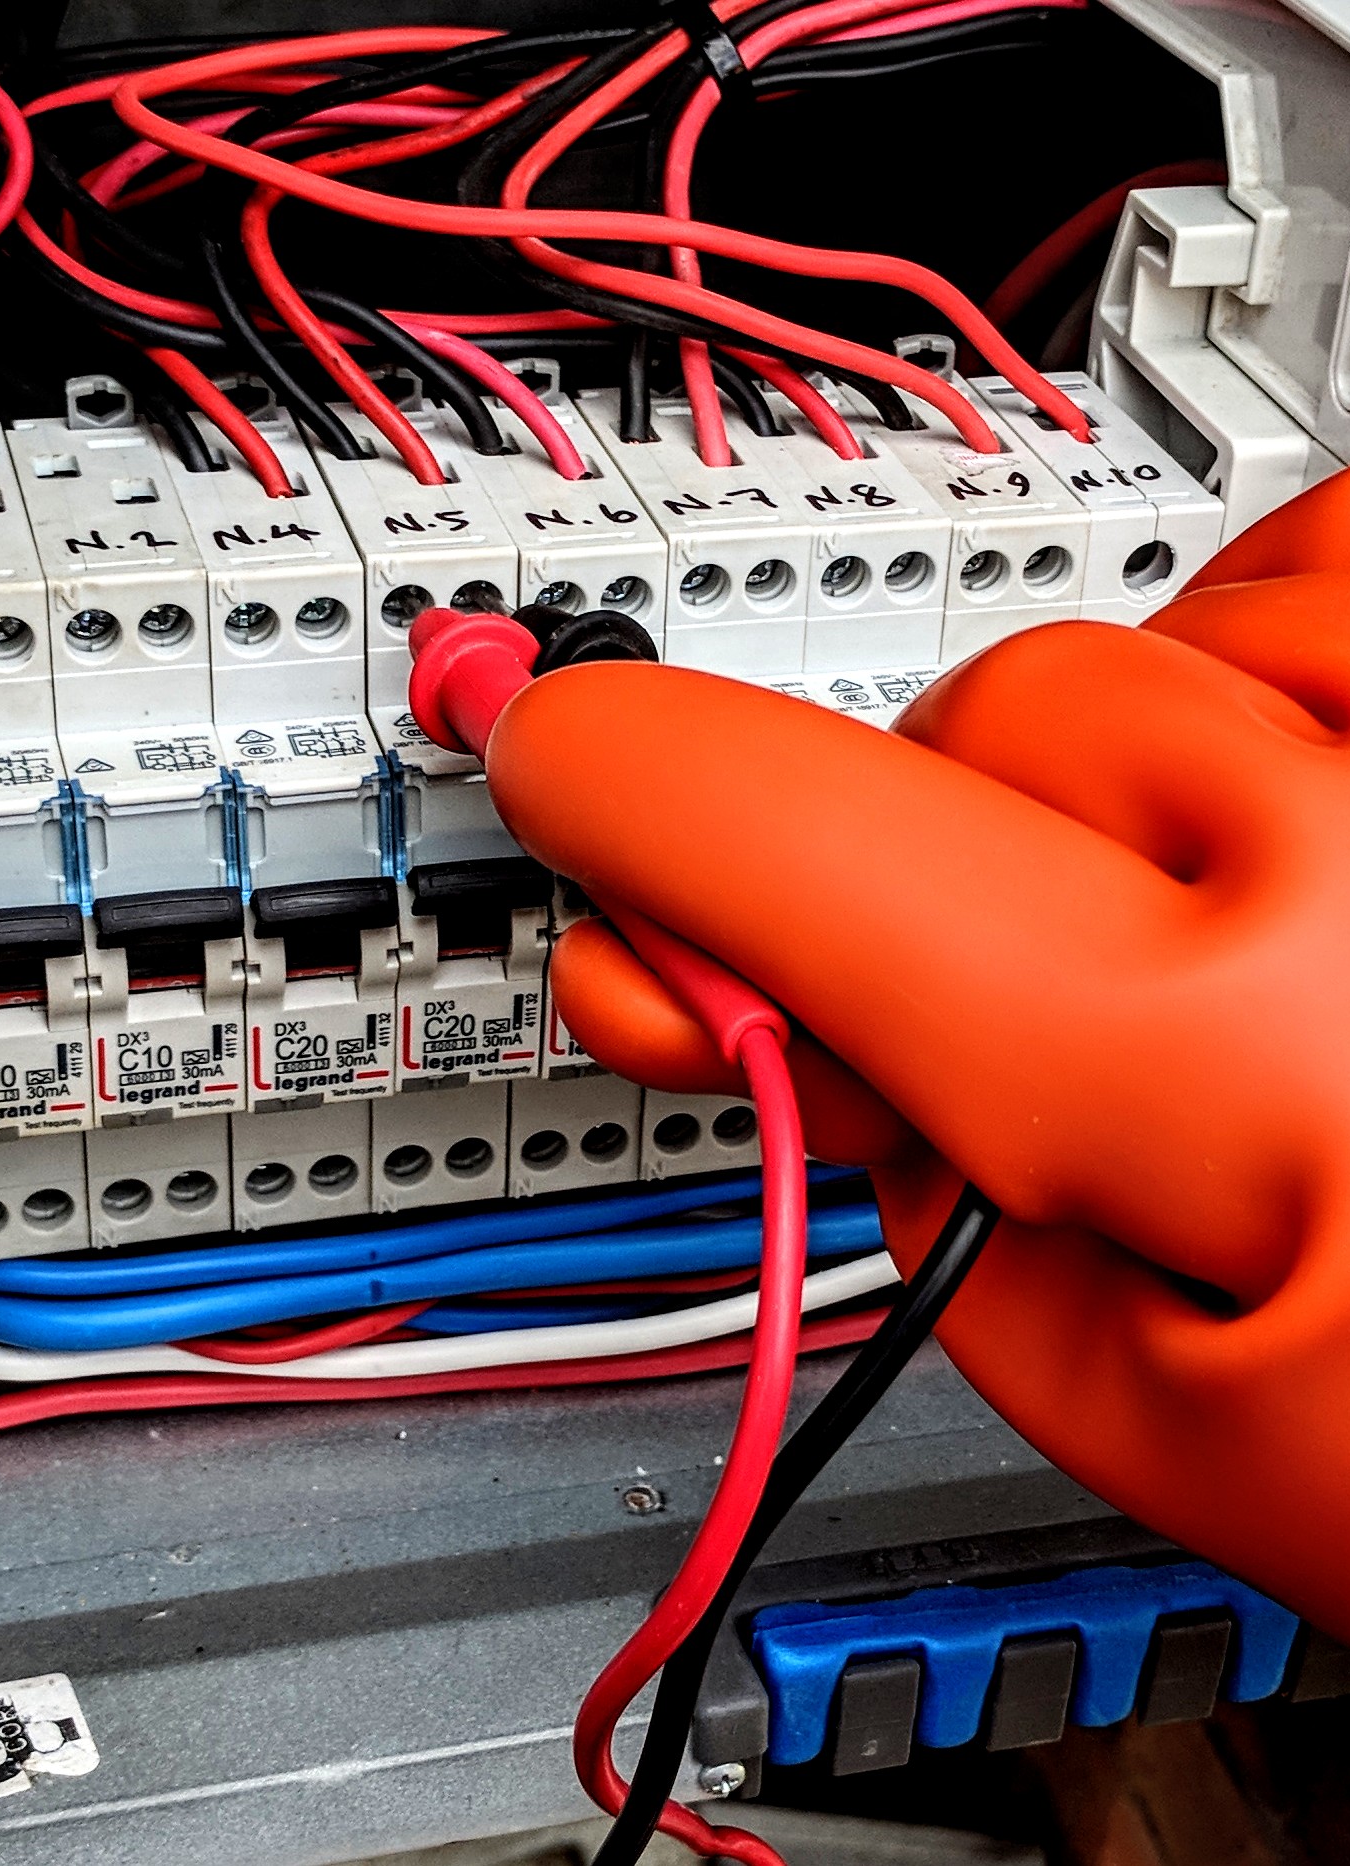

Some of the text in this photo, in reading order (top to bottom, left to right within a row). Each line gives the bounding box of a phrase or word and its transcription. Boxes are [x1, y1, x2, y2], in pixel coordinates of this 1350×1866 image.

[805, 483, 897, 512] N.8
[948, 472, 1030, 500] N.9
[663, 488, 778, 515] N.7
[384, 510, 470, 534] N.5
[525, 504, 638, 529] N.6
[66, 530, 178, 554] N.2
[214, 523, 320, 550] N.4
[525, 993, 538, 1004] 32
[225, 1023, 237, 1034] 29
[379, 1013, 391, 1023] 32
[424, 1014, 475, 1039] C20
[70, 1042, 82, 1053] 29
[276, 1035, 328, 1060] C20
[483, 1033, 523, 1048] 30mA
[119, 1045, 172, 1071] C10
[337, 1053, 377, 1068] 30mA
[423, 1049, 499, 1071] legrand
[182, 1064, 224, 1079] 30mA
[275, 1069, 354, 1092] legrand
[27, 1086, 70, 1099] 30mA
[120, 1080, 200, 1104] legrand
